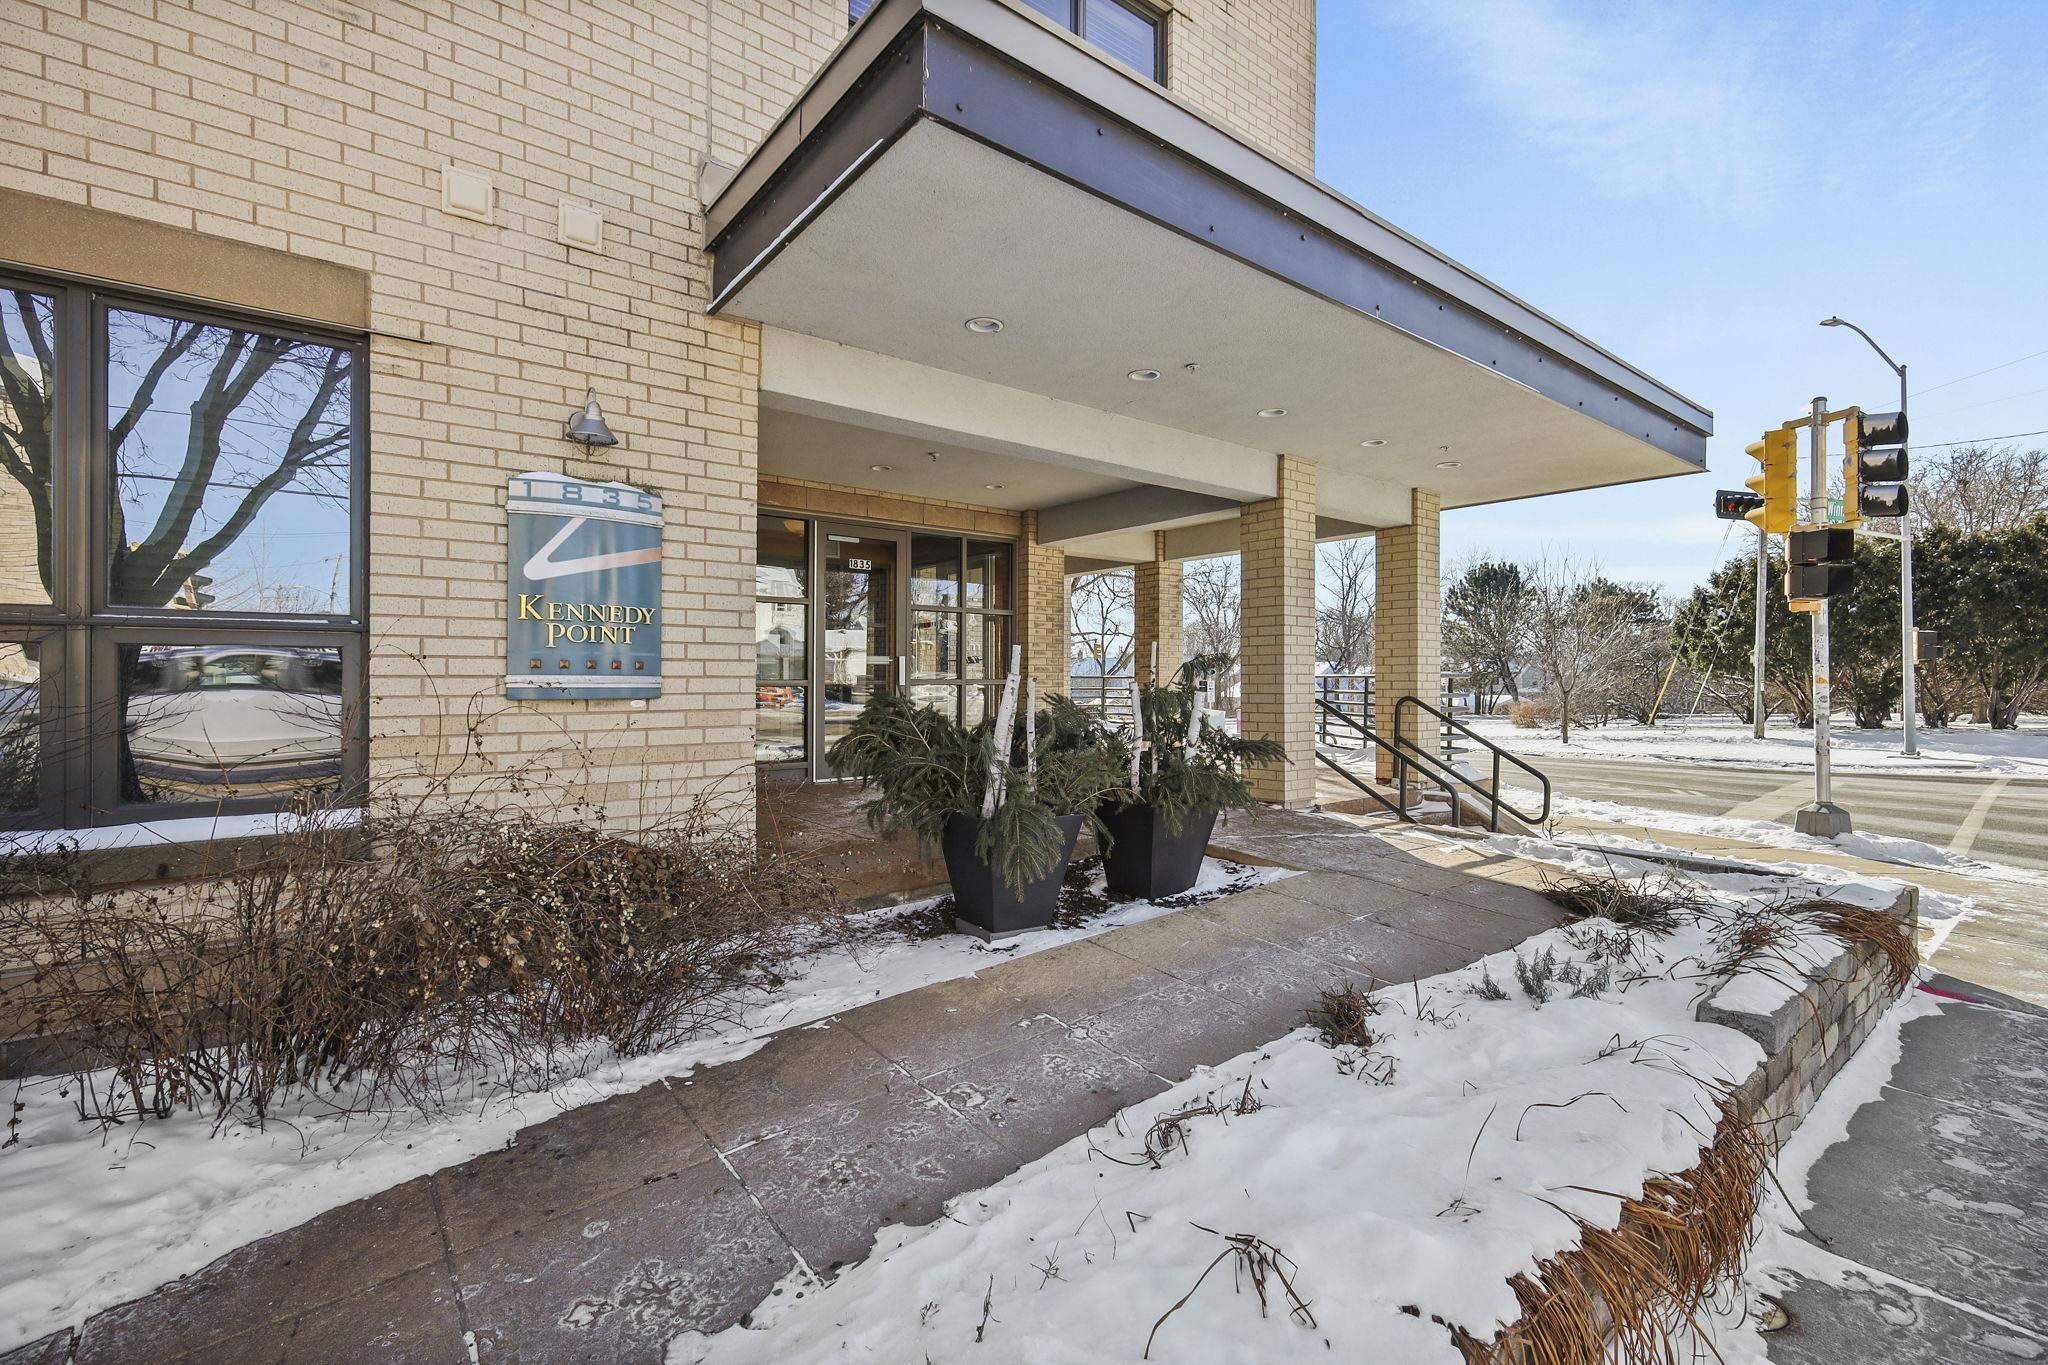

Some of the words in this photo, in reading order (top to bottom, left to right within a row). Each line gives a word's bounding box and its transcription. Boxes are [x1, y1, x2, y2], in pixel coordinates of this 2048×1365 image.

[523, 480, 652, 510] 1835
[849, 559, 871, 570] 1835
[518, 593, 656, 625] KENNEDY
[545, 622, 636, 648] POINT
